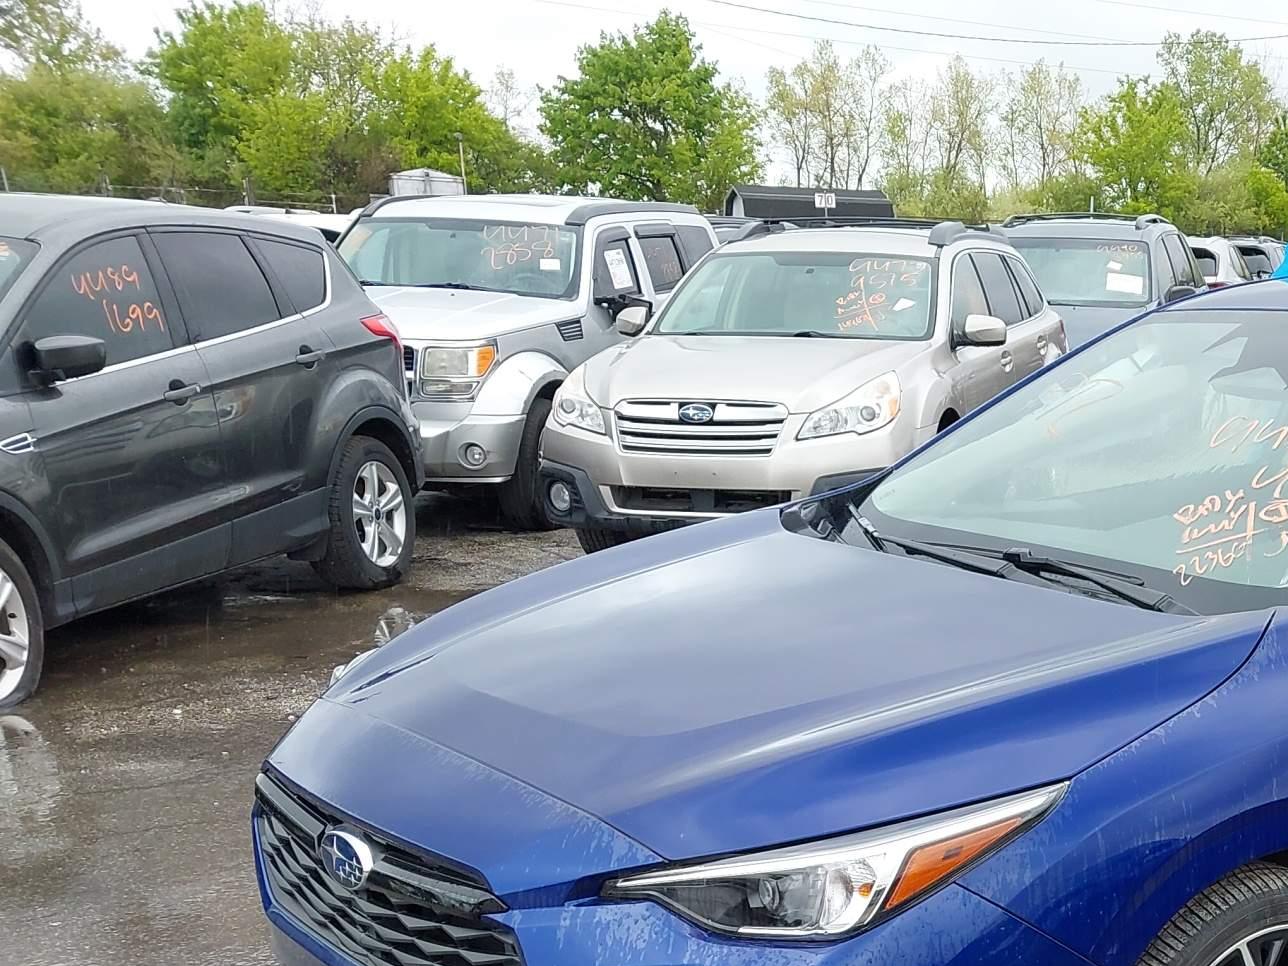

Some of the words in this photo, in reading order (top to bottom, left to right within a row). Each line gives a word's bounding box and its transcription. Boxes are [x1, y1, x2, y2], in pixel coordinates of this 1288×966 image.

[817, 194, 833, 206] 70
[71, 264, 140, 300] 4489
[102, 299, 164, 334] 1699
